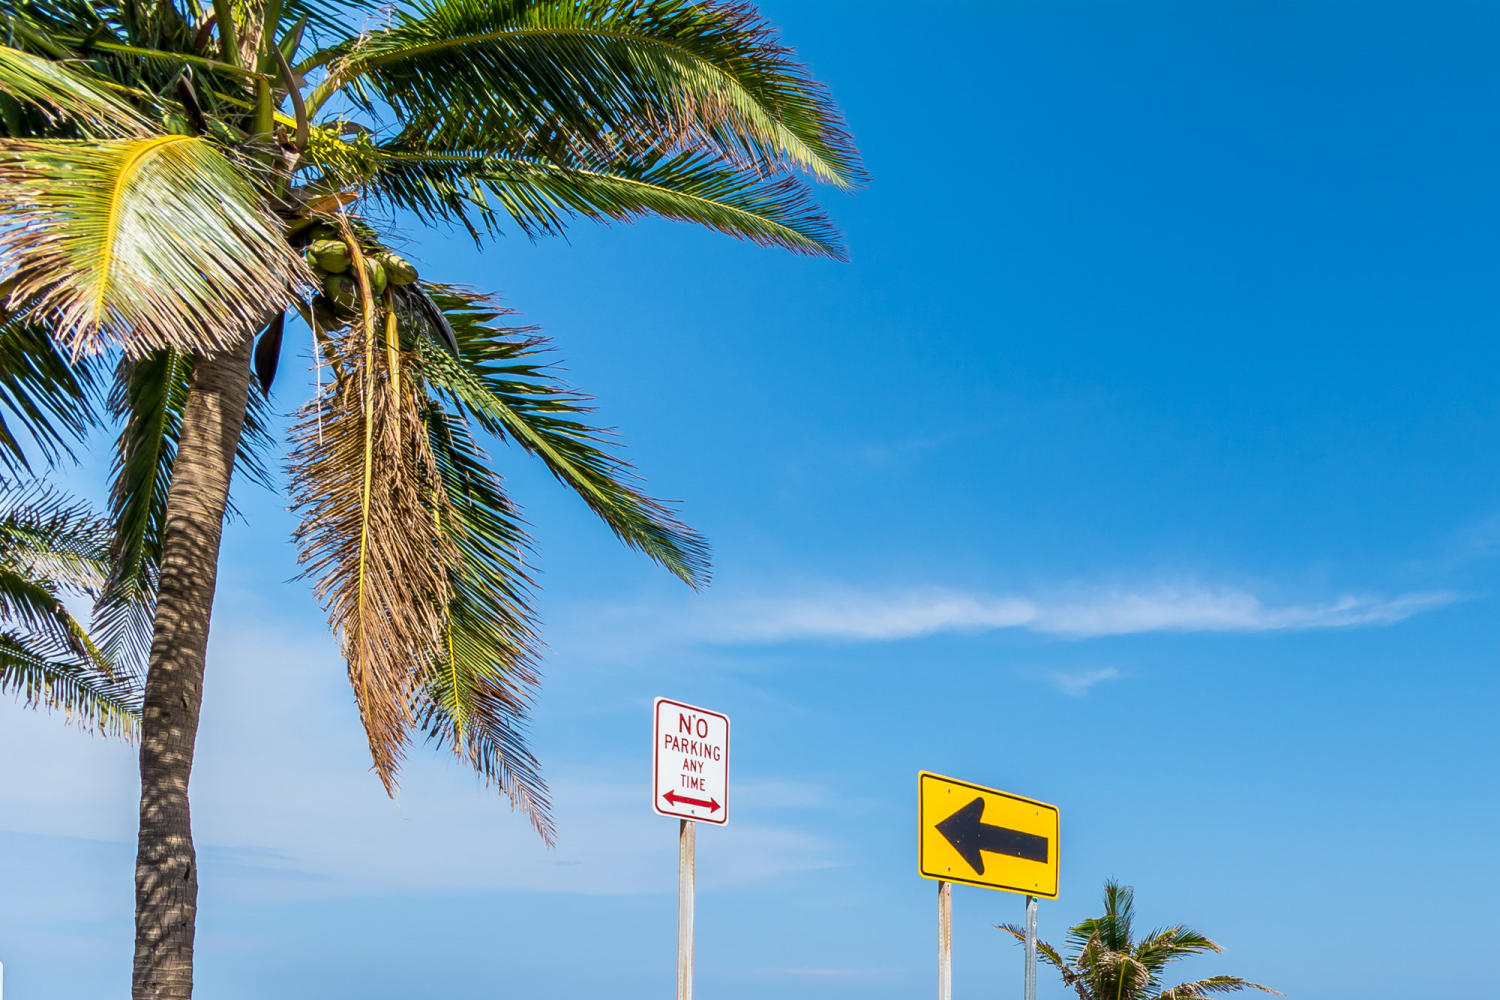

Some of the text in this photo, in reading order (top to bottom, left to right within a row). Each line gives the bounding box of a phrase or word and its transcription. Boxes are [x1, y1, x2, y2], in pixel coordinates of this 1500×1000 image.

[679, 713, 708, 739] NO
[664, 734, 721, 761] PARKING
[682, 758, 704, 774] ANY
[681, 774, 706, 792] TIME
